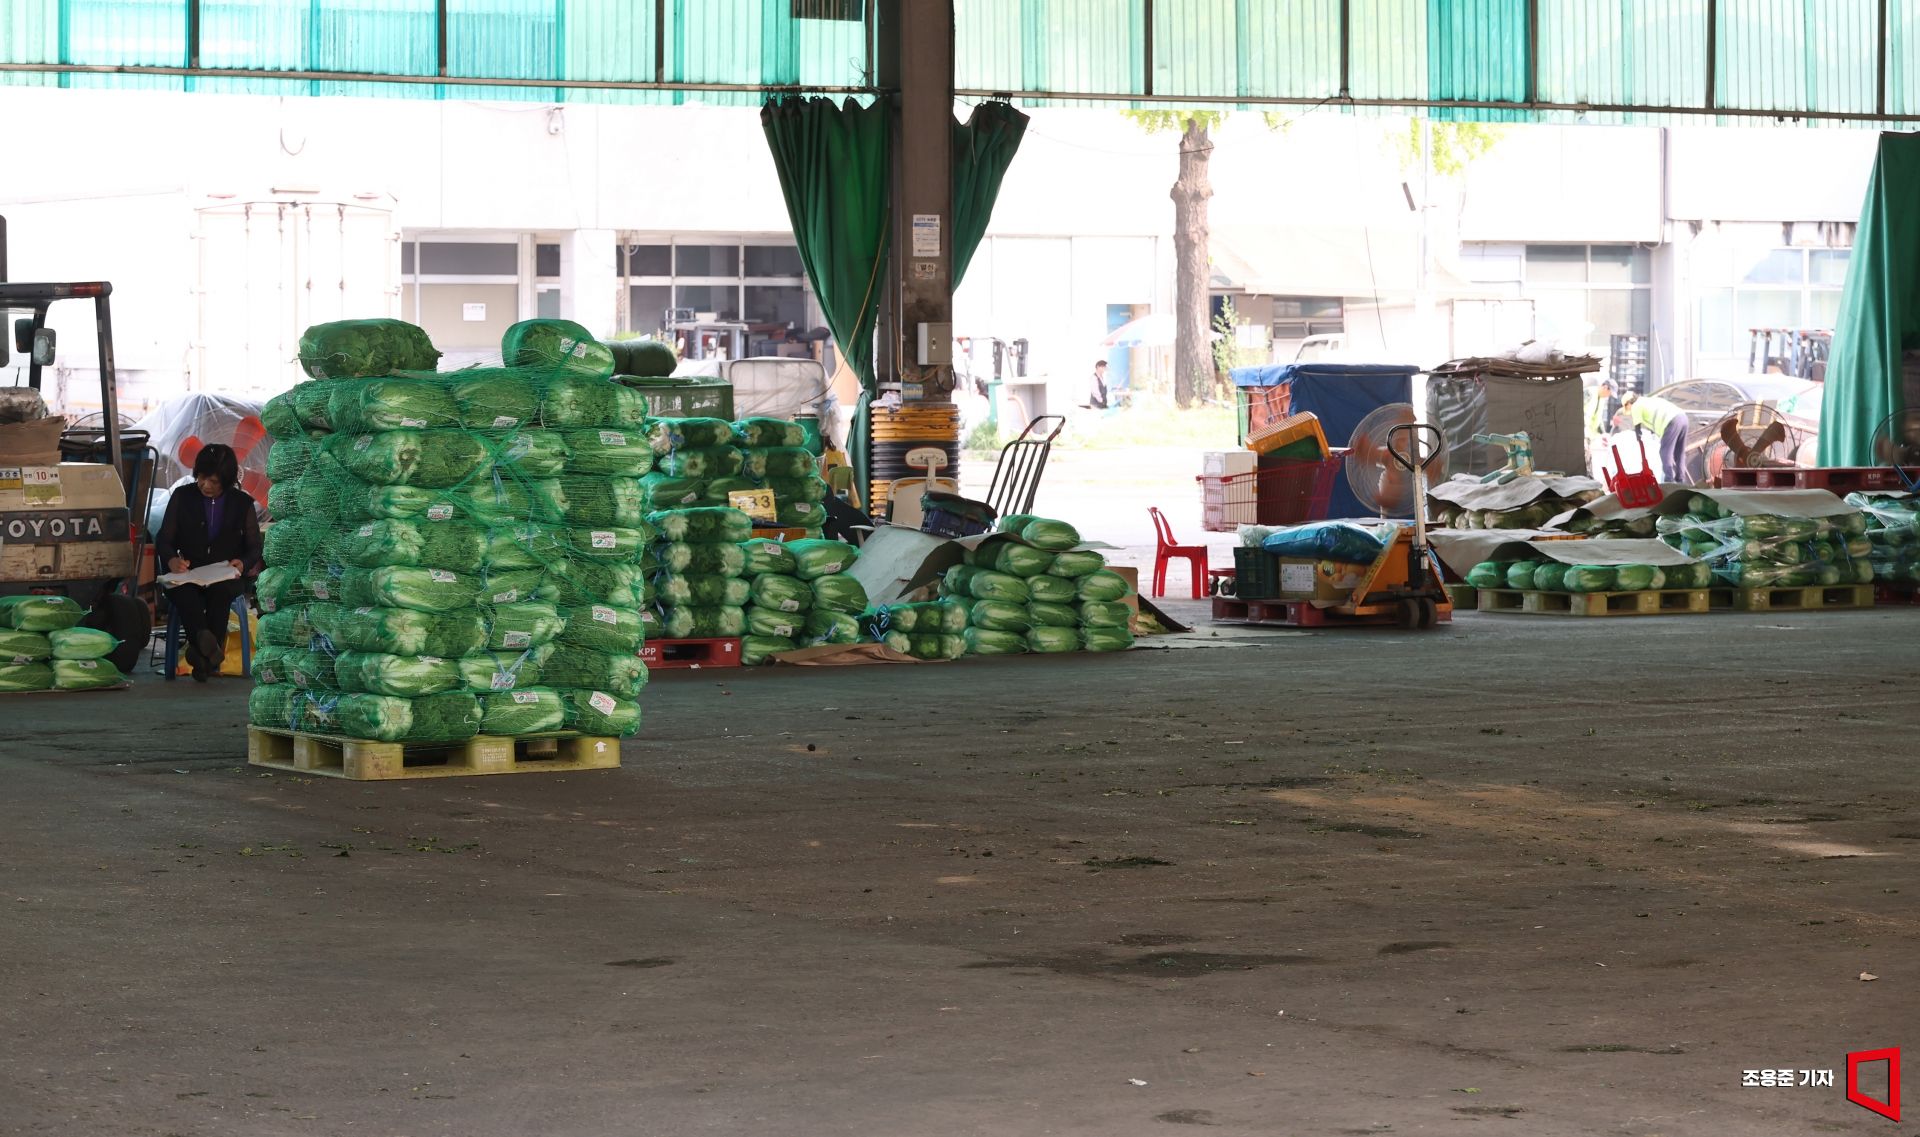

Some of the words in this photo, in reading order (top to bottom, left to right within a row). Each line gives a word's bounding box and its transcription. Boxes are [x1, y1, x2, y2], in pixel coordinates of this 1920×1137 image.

[36, 471, 47, 481] 10
[0, 517, 102, 538] OYOTA
[638, 647, 657, 656] KPP
